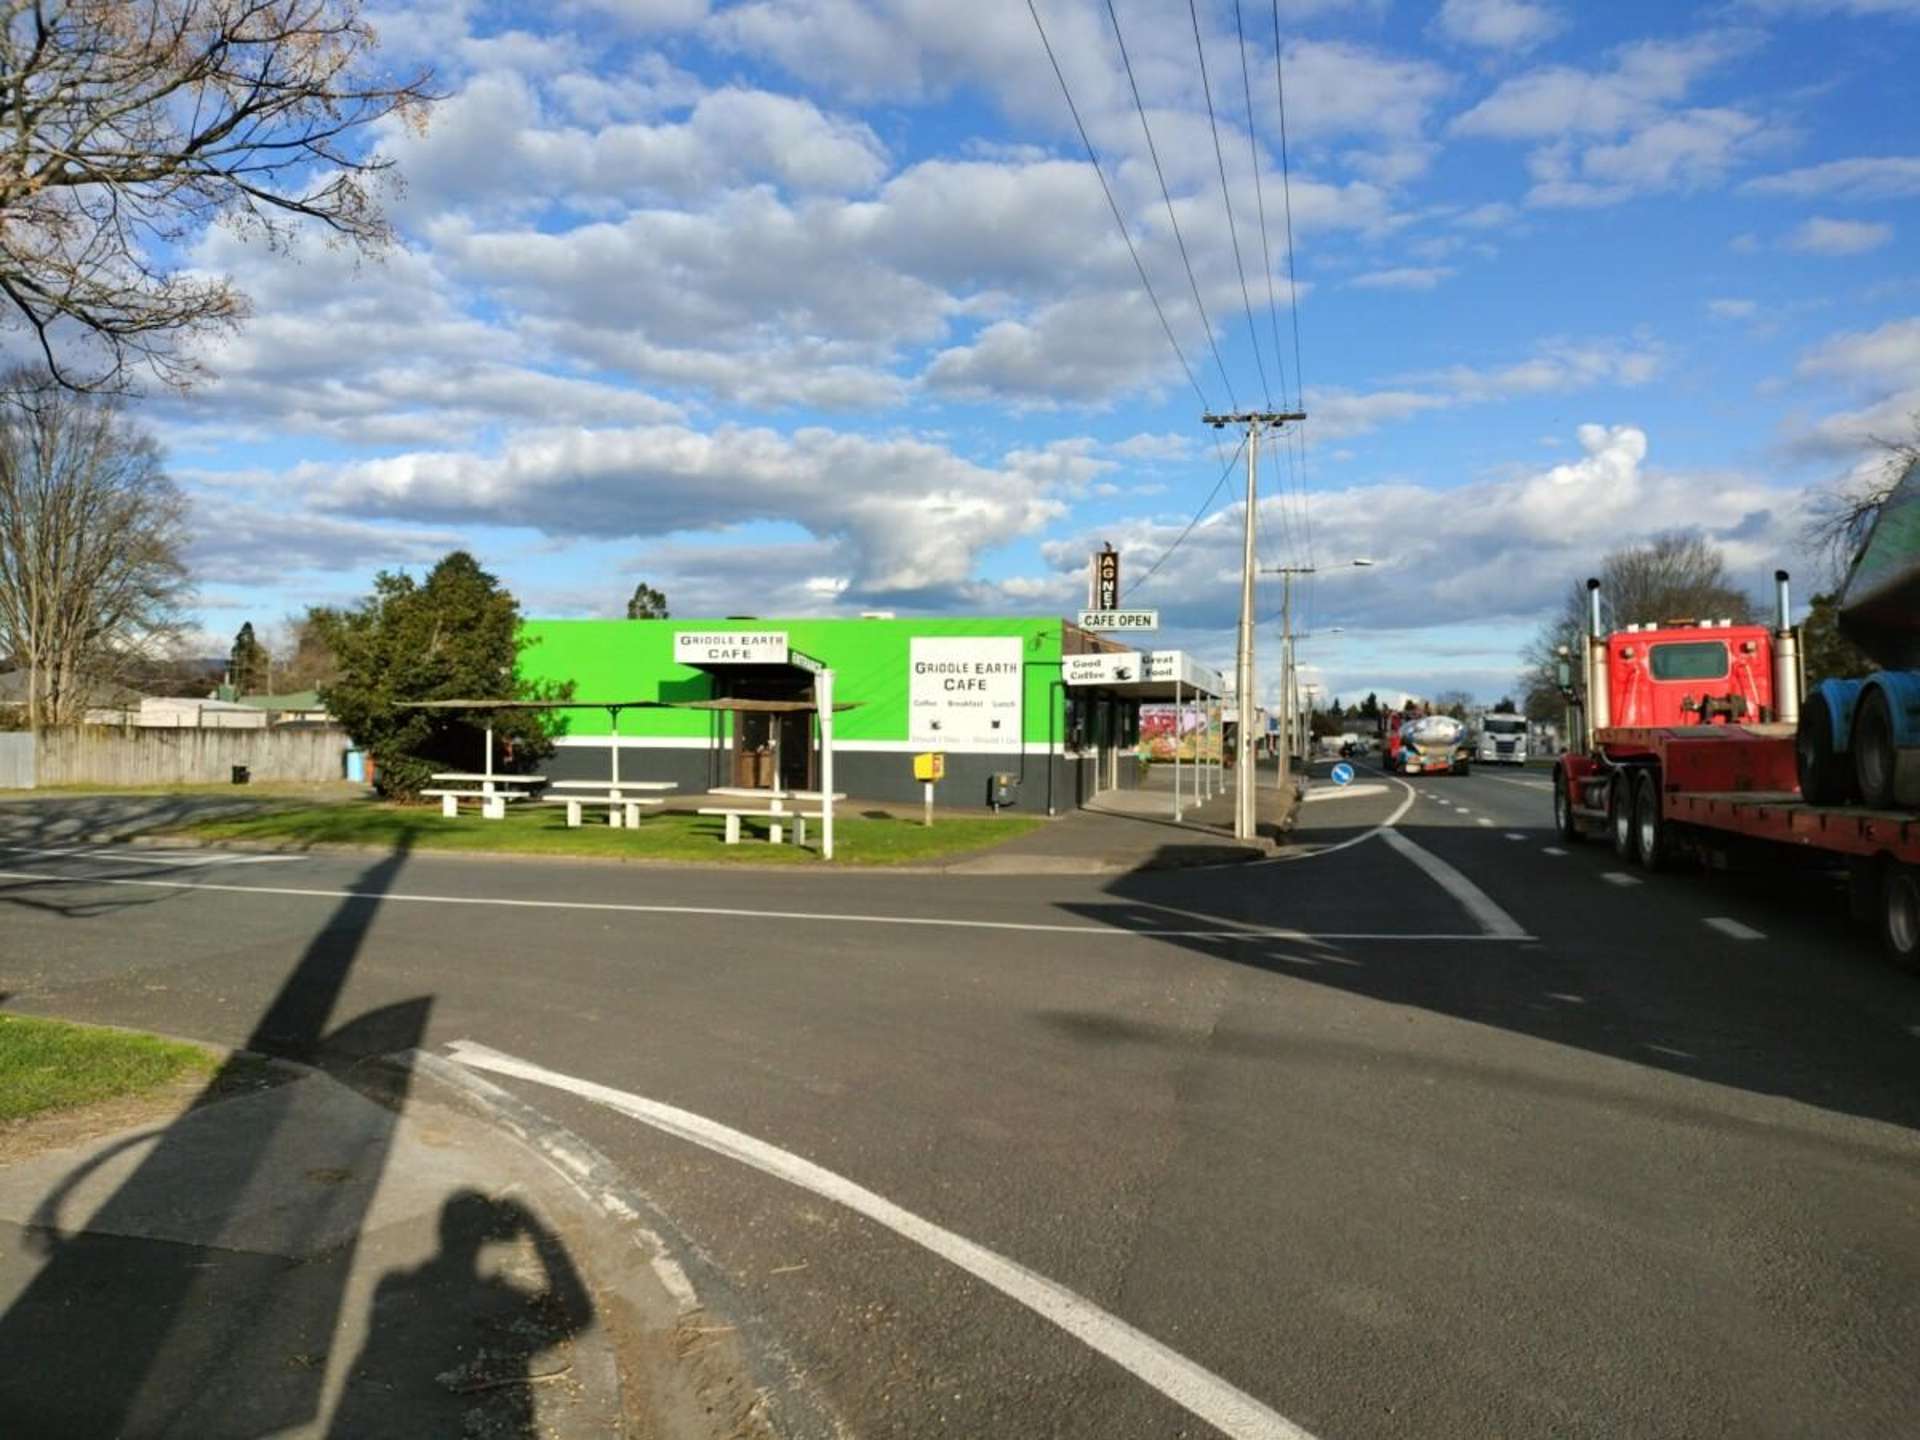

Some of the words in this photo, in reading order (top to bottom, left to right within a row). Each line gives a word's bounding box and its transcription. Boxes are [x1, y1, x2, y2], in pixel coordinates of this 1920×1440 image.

[1084, 615, 1115, 626] CAFE
[1119, 615, 1151, 626] OPEN
[680, 636, 735, 646] GRIDDLE
[741, 636, 784, 646] EARTH
[708, 649, 751, 659] CAFE
[1142, 655, 1173, 664] Great
[915, 662, 968, 674] GRIDDLE
[975, 663, 1017, 674] EARTH
[1145, 668, 1172, 677] Food
[944, 678, 987, 691] CAFE
